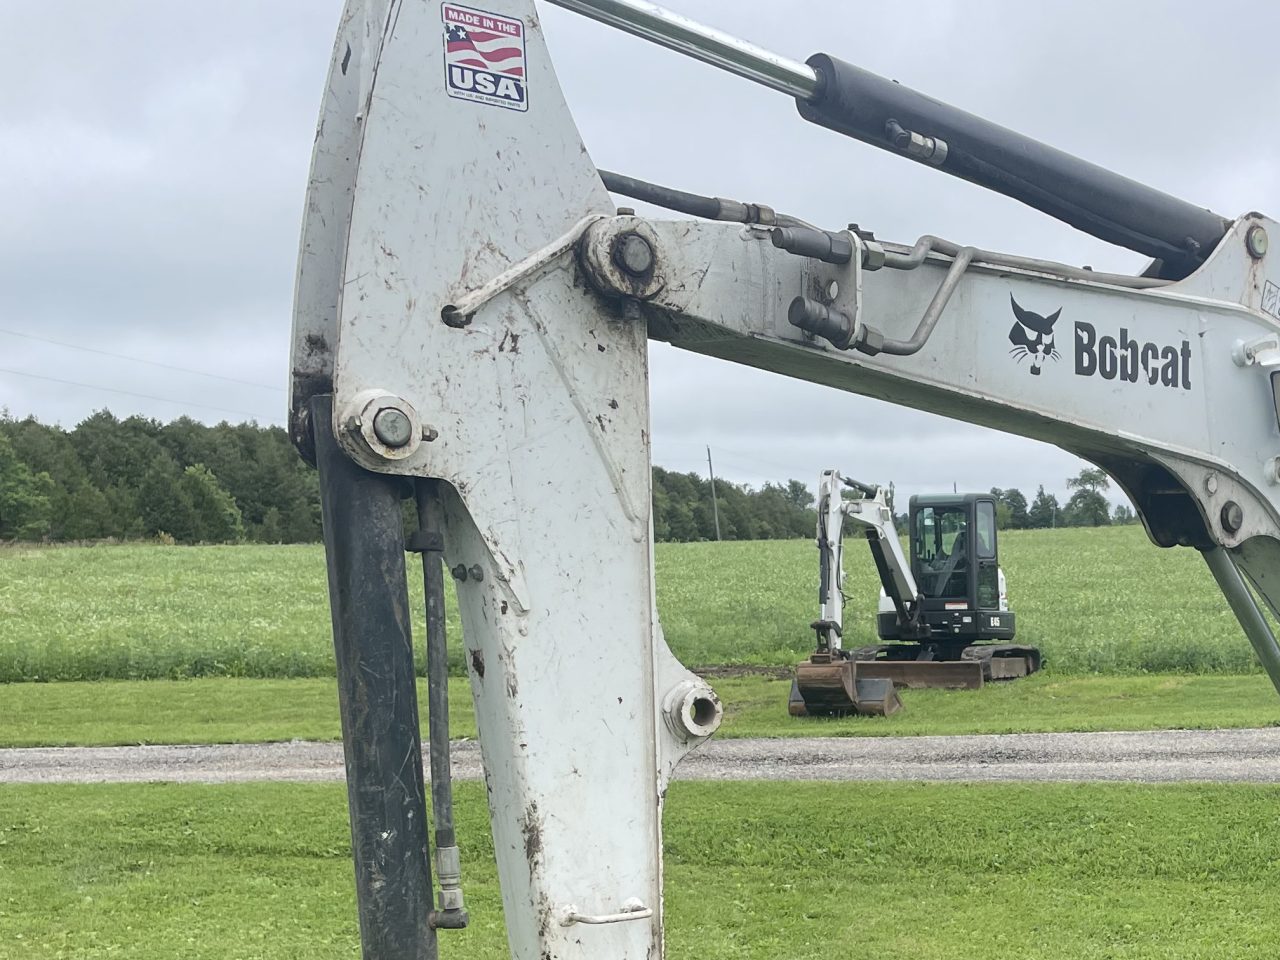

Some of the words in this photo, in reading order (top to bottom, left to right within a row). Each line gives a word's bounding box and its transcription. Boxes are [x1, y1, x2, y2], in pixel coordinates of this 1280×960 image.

[448, 10, 480, 25] MADE
[482, 18, 494, 29] IN
[496, 21, 517, 34] THE
[451, 66, 520, 100] USA
[1074, 320, 1192, 391] Bobcat
